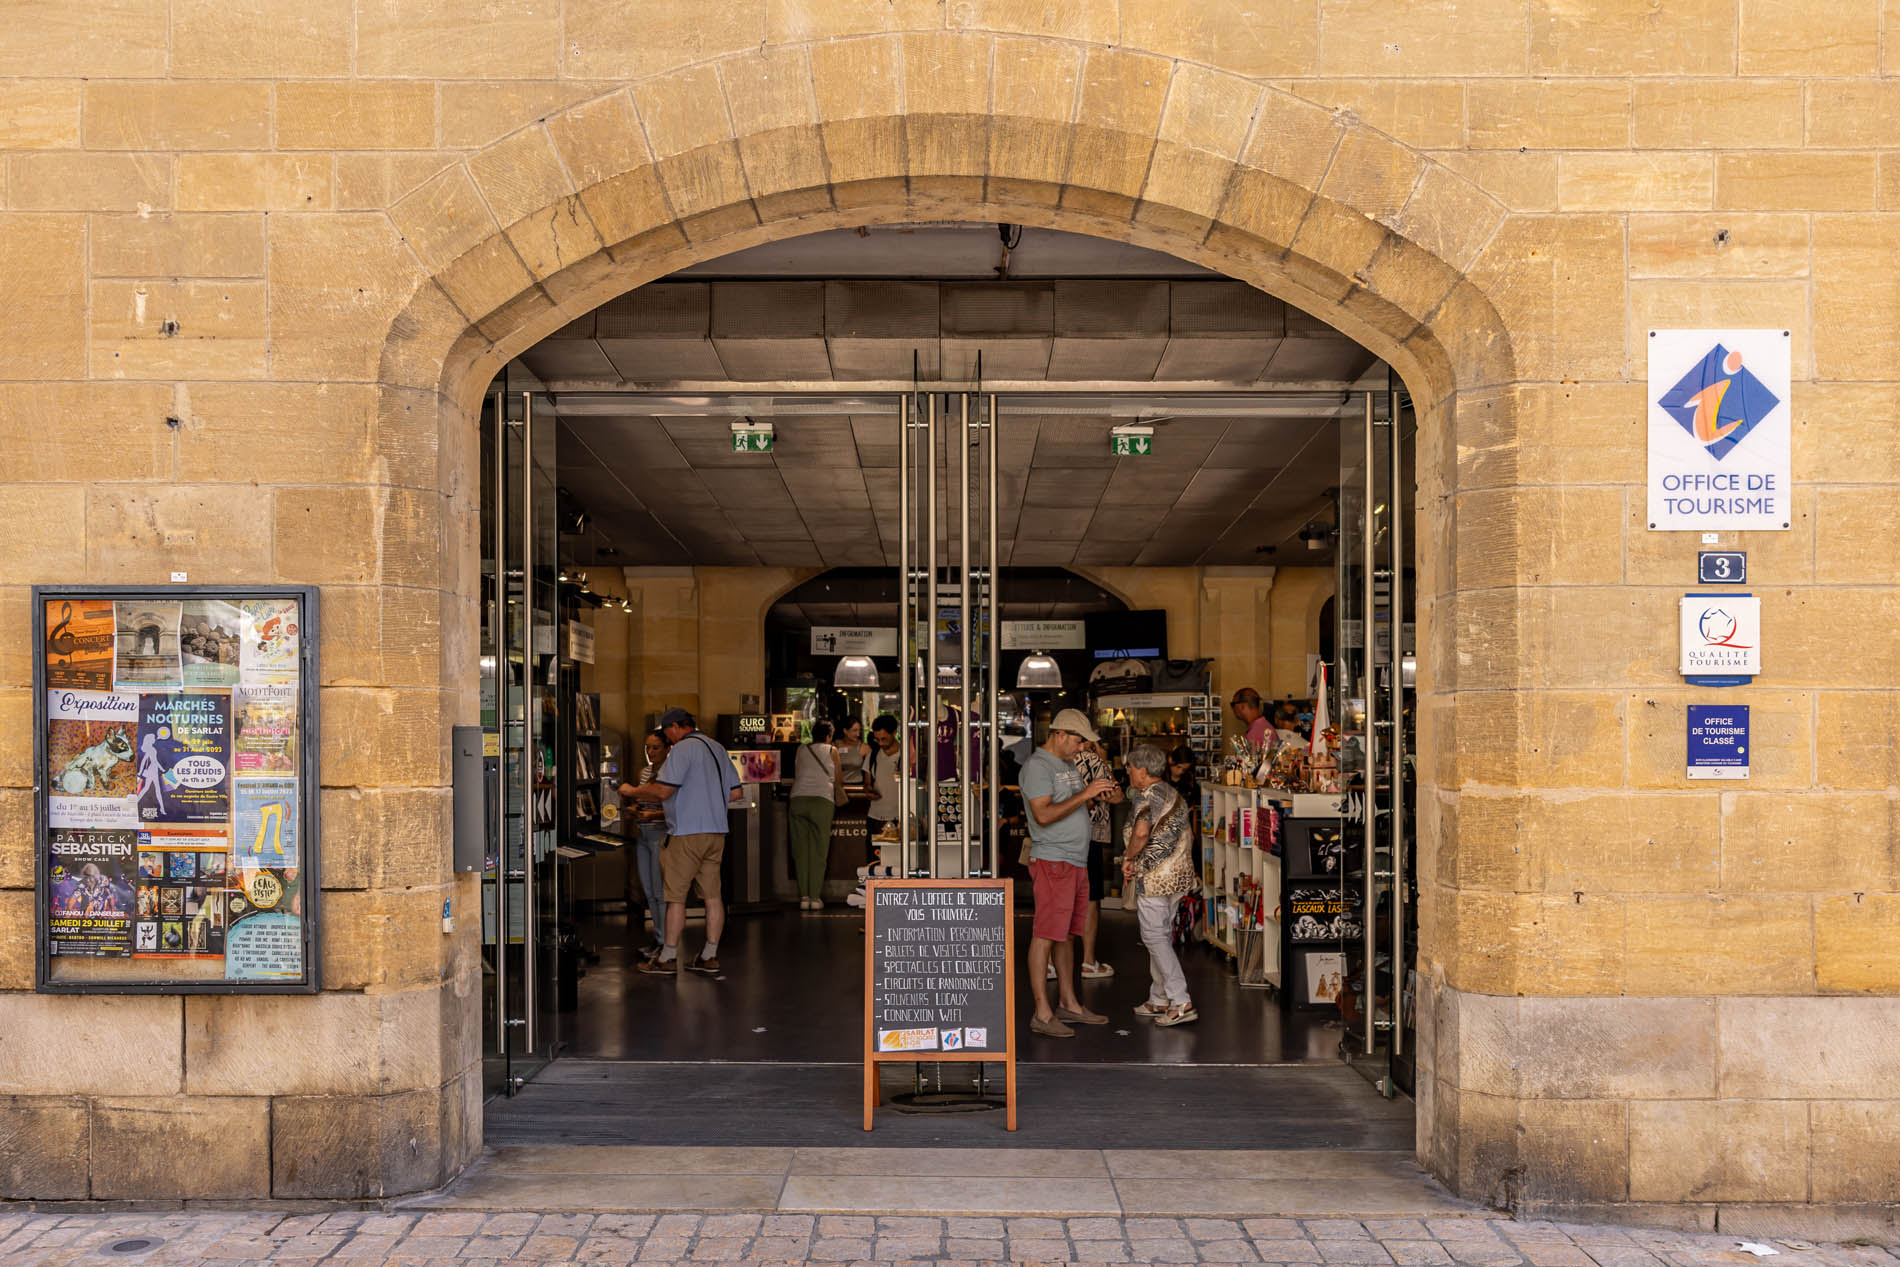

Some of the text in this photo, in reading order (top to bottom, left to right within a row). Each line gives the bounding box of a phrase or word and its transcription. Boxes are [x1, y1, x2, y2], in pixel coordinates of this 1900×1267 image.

[1662, 474, 1776, 491] OFFICE DE
[1663, 498, 1775, 515] TOURISME
[1714, 557, 1731, 578] 3
[60, 692, 138, 715] Exposition
[154, 698, 216, 711] MARCHÉS
[146, 713, 224, 724] NOCTURNES
[177, 727, 224, 735] DE SARLAT
[1692, 727, 1746, 735] DE TOURISME
[1703, 736, 1735, 745] CLASSÉ
[99, 803, 121, 812] juillet
[56, 834, 127, 843] PATRICK
[51, 842, 132, 856] SEBASTIEN
[876, 890, 1005, 906] ENTREZ À L'OFFICE DE TOURISME
[904, 908, 925, 921] VOUS
[1292, 904, 1325, 913] LASCAUX
[50, 919, 126, 928] SAMEDI 29 JUILLET
[50, 926, 80, 934] SARLAT
[887, 927, 945, 942] INFORMATION
[885, 945, 915, 958] BILLETS
[919, 945, 930, 957] DE
[932, 944, 968, 958] VISITES
[884, 960, 1001, 974] SPECTACLES ET CONCERTS
[884, 977, 924, 990] CIRCUITS
[926, 977, 937, 990] DE
[938, 976, 994, 991] RANDONNÉES
[884, 992, 929, 1006] SOUVENIRS
[935, 992, 969, 1006] LOCAUX
[884, 1008, 934, 1022] CONNEXION
[939, 1008, 962, 1022] WIFI
